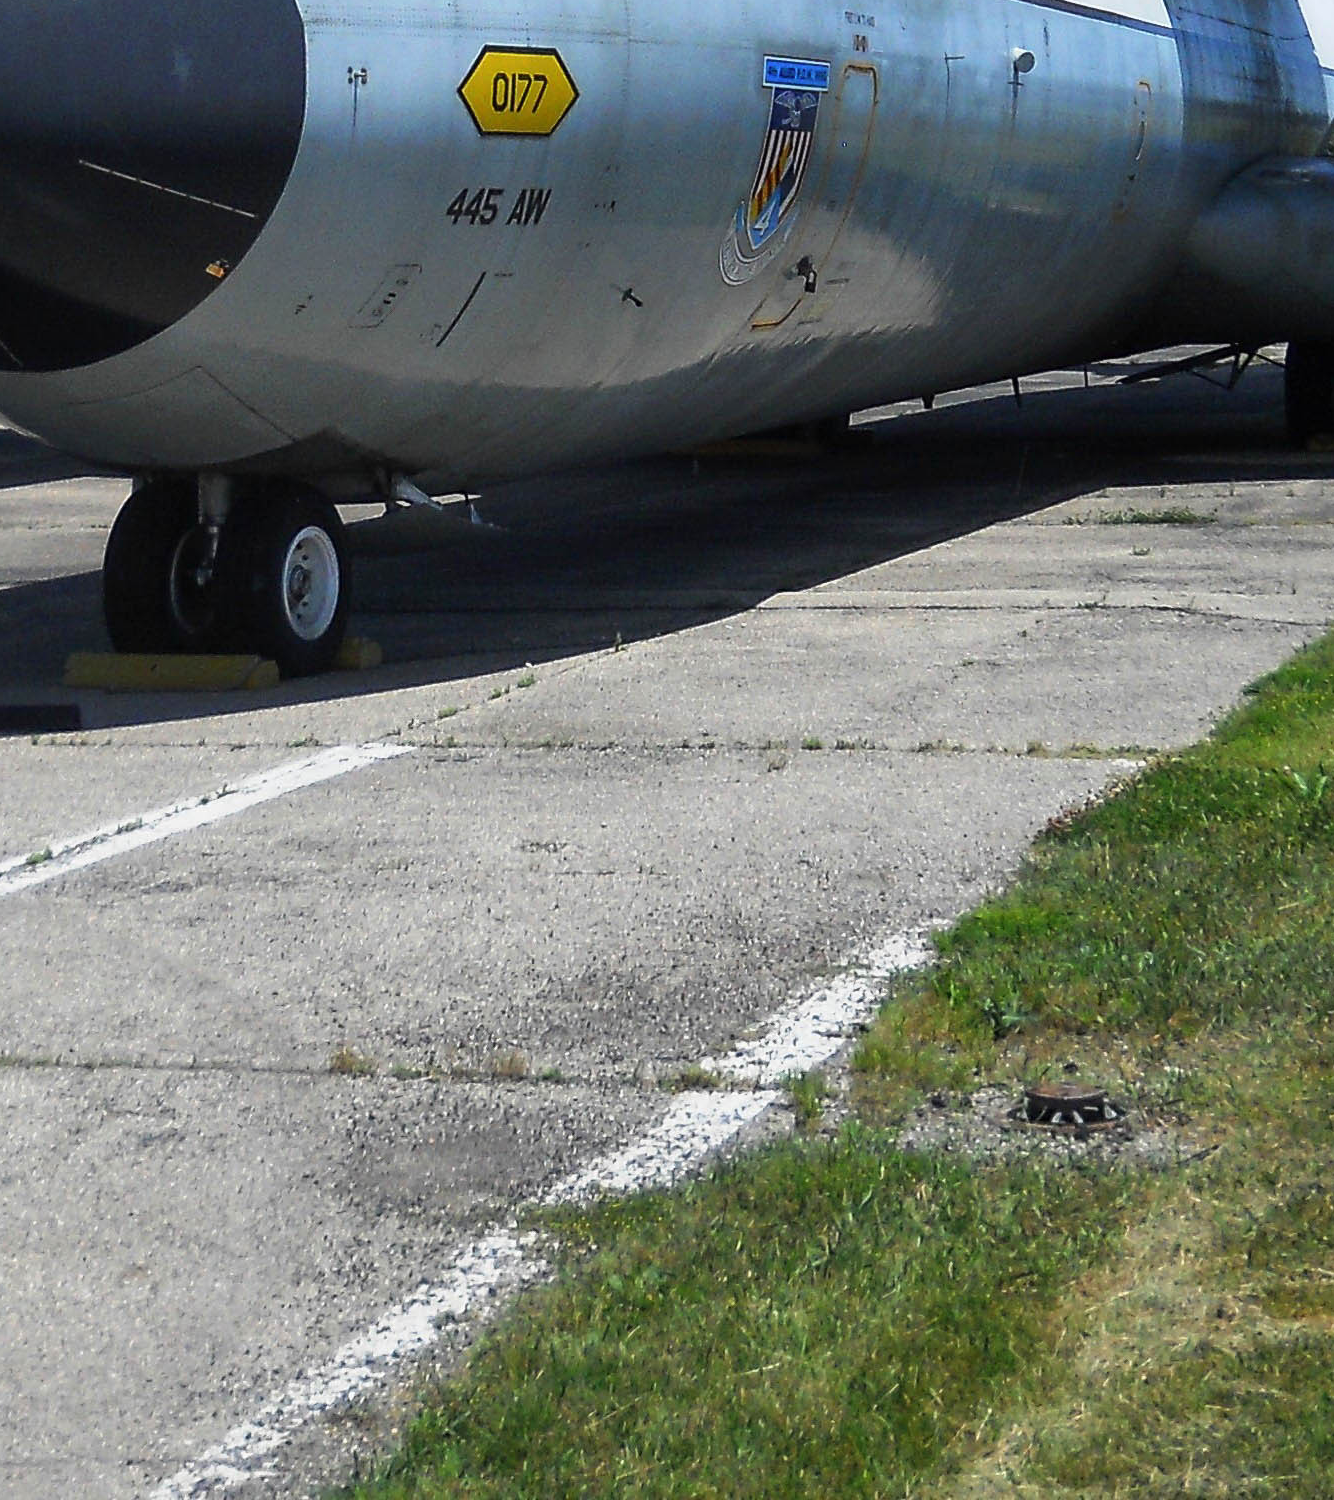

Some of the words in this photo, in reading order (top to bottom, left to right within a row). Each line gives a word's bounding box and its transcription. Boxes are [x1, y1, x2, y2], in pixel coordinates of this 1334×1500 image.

[492, 72, 548, 114] 0177
[446, 187, 504, 226] 445
[505, 187, 552, 227] AW
